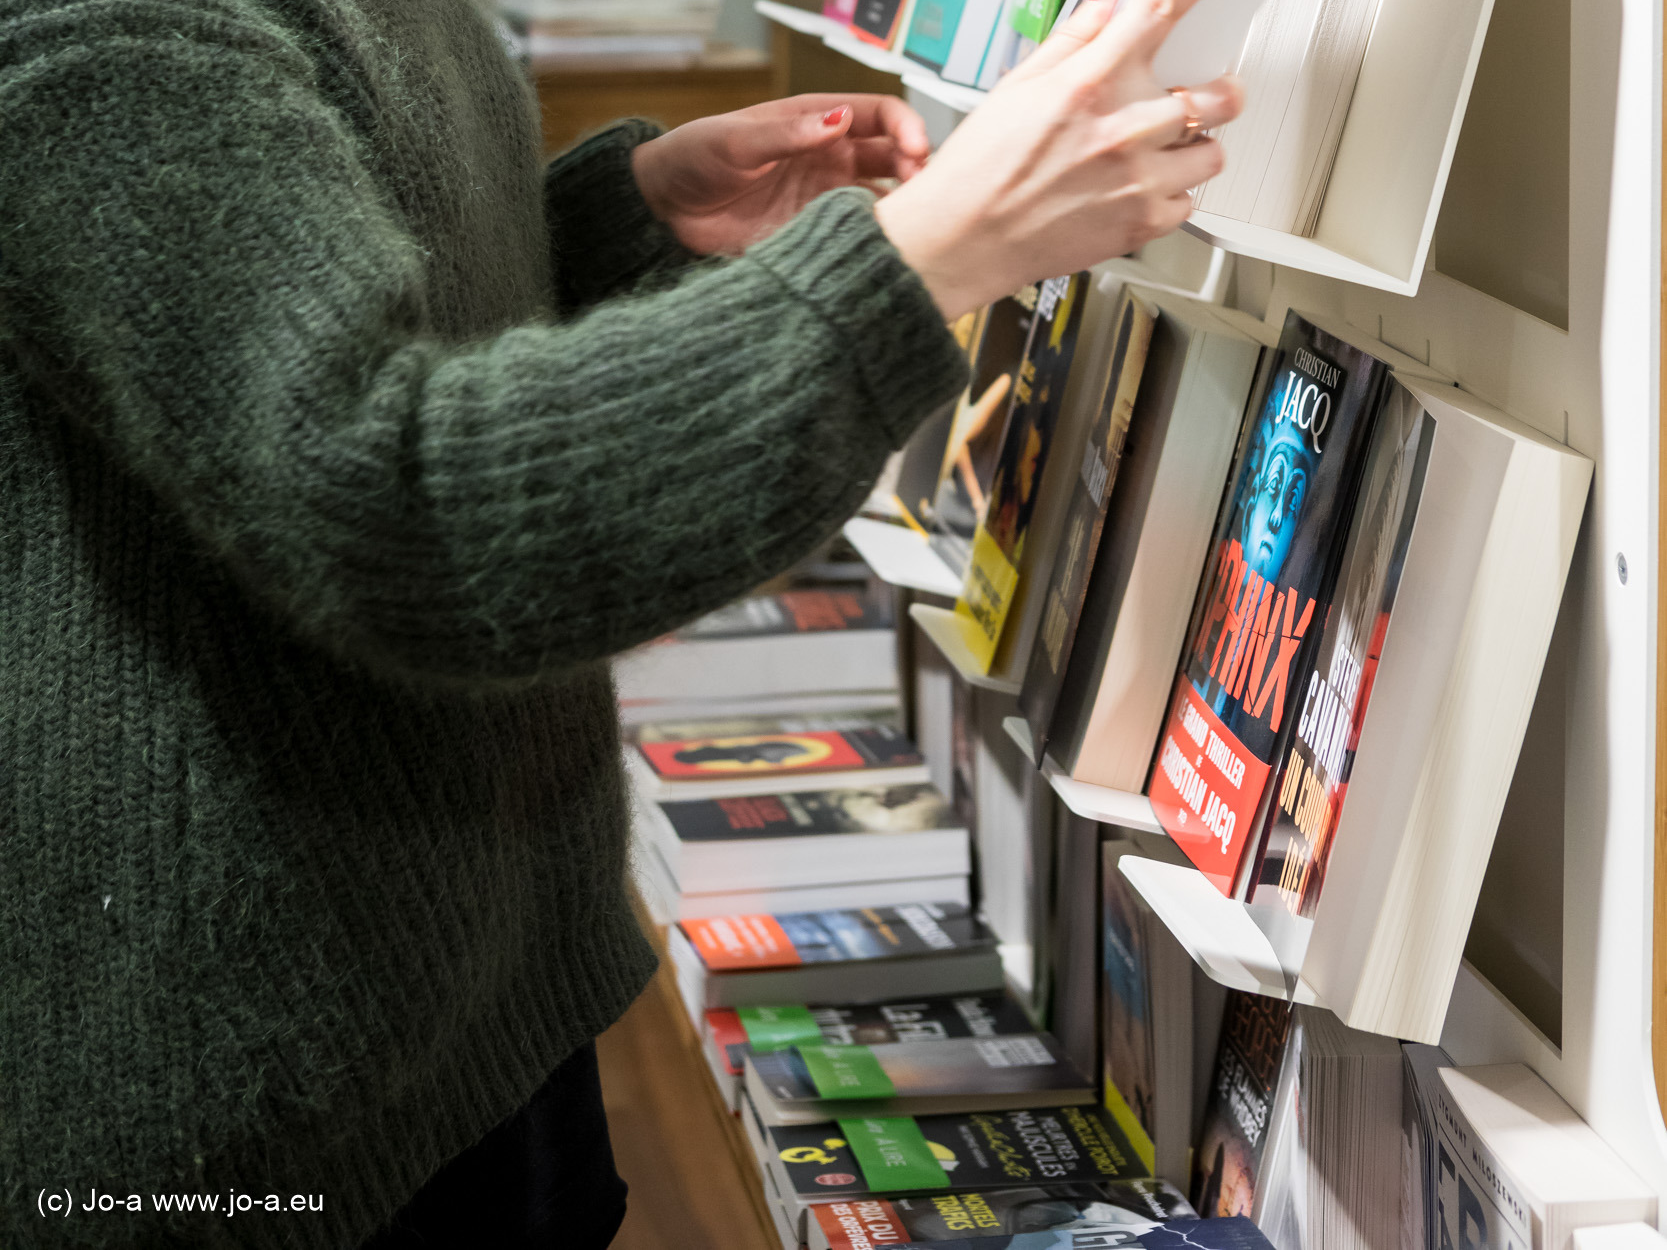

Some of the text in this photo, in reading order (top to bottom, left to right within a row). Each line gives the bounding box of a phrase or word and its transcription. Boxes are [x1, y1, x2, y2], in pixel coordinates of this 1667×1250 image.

[1295, 347, 1341, 389] CHRISTIAN
[1275, 370, 1331, 454] JACQ
[1332, 643, 1360, 710] STEVE
[1178, 694, 1246, 790] LE GRAND THRILLER
[1195, 754, 1203, 768] DE
[1161, 735, 1236, 854] CHRISTIAN JACQ
[1280, 747, 1304, 816] UN
[1007, 1110, 1068, 1178] MAJUSCULES
[1438, 1093, 1467, 1149] ZYGMUNT
[830, 1203, 853, 1215] DES
[838, 1216, 874, 1250] ORFÈVRE
[854, 1200, 899, 1240] PRIX DU
[931, 1196, 975, 1231] TRAFICS
[958, 1193, 1001, 1228] MORTELS
